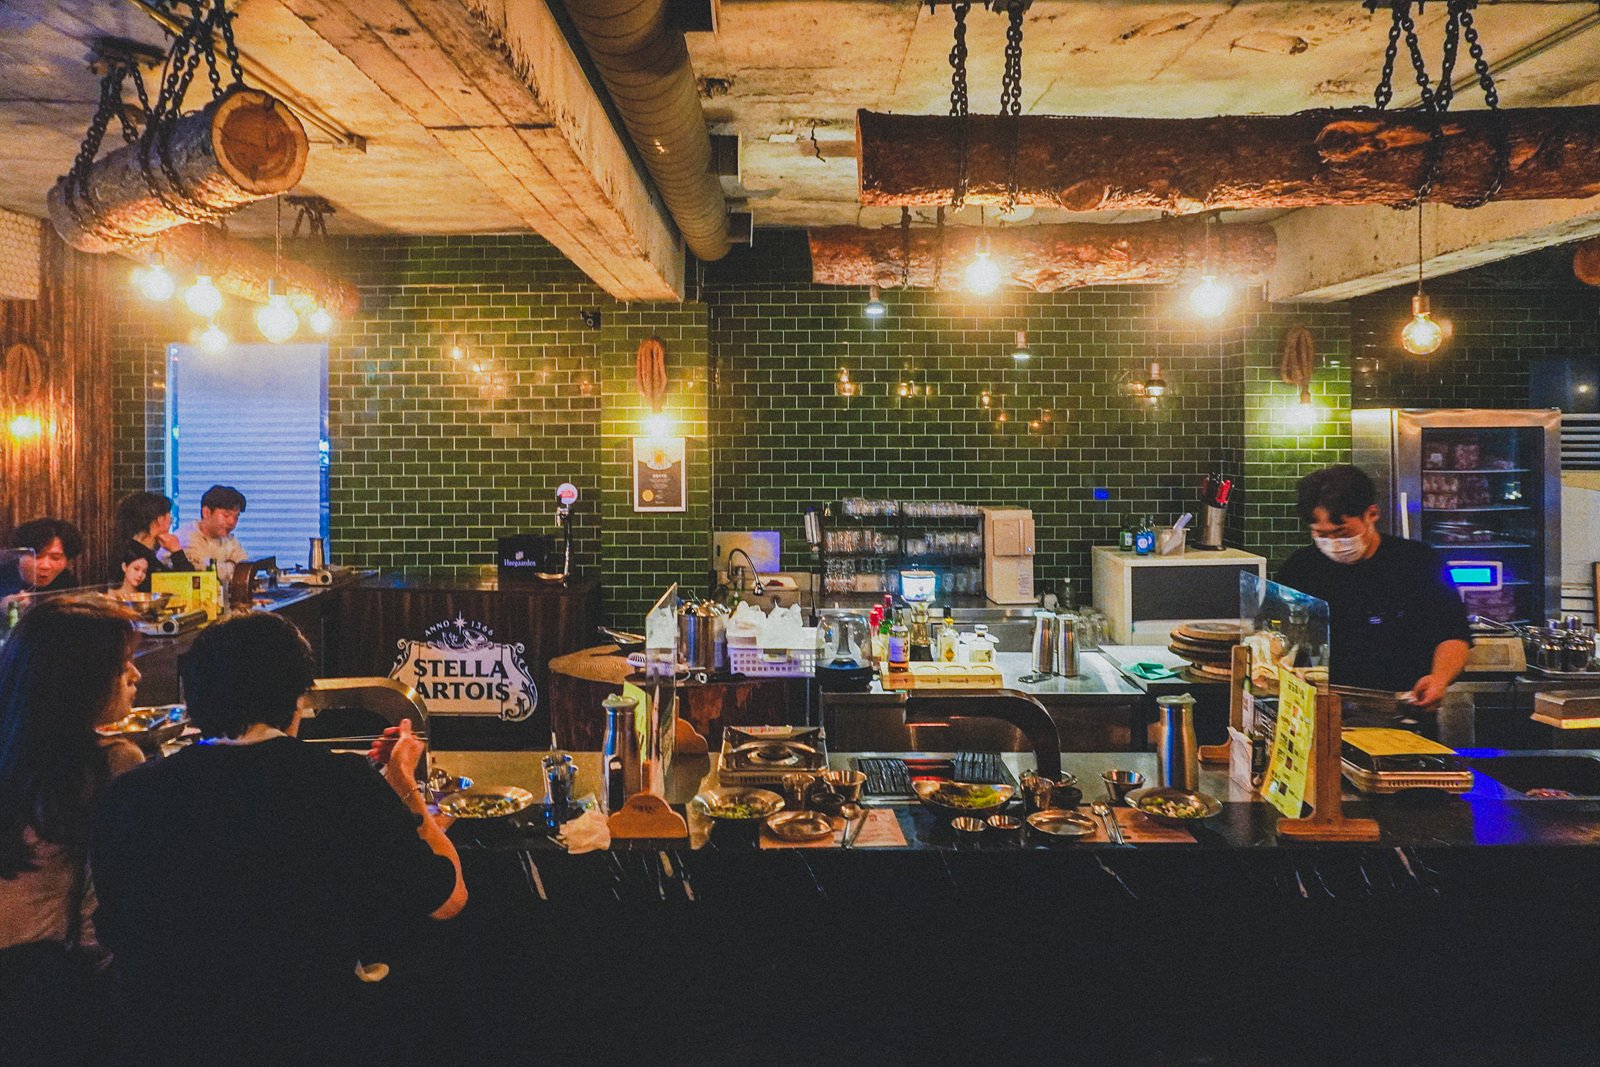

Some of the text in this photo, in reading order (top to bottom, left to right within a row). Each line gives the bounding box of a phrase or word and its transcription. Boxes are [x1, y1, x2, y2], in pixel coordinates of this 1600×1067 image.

[504, 558, 536, 568] Hoegaarden
[425, 620, 494, 637] ANNO 1366
[414, 659, 509, 680] STELLA
[416, 682, 510, 701] ARTOIS
